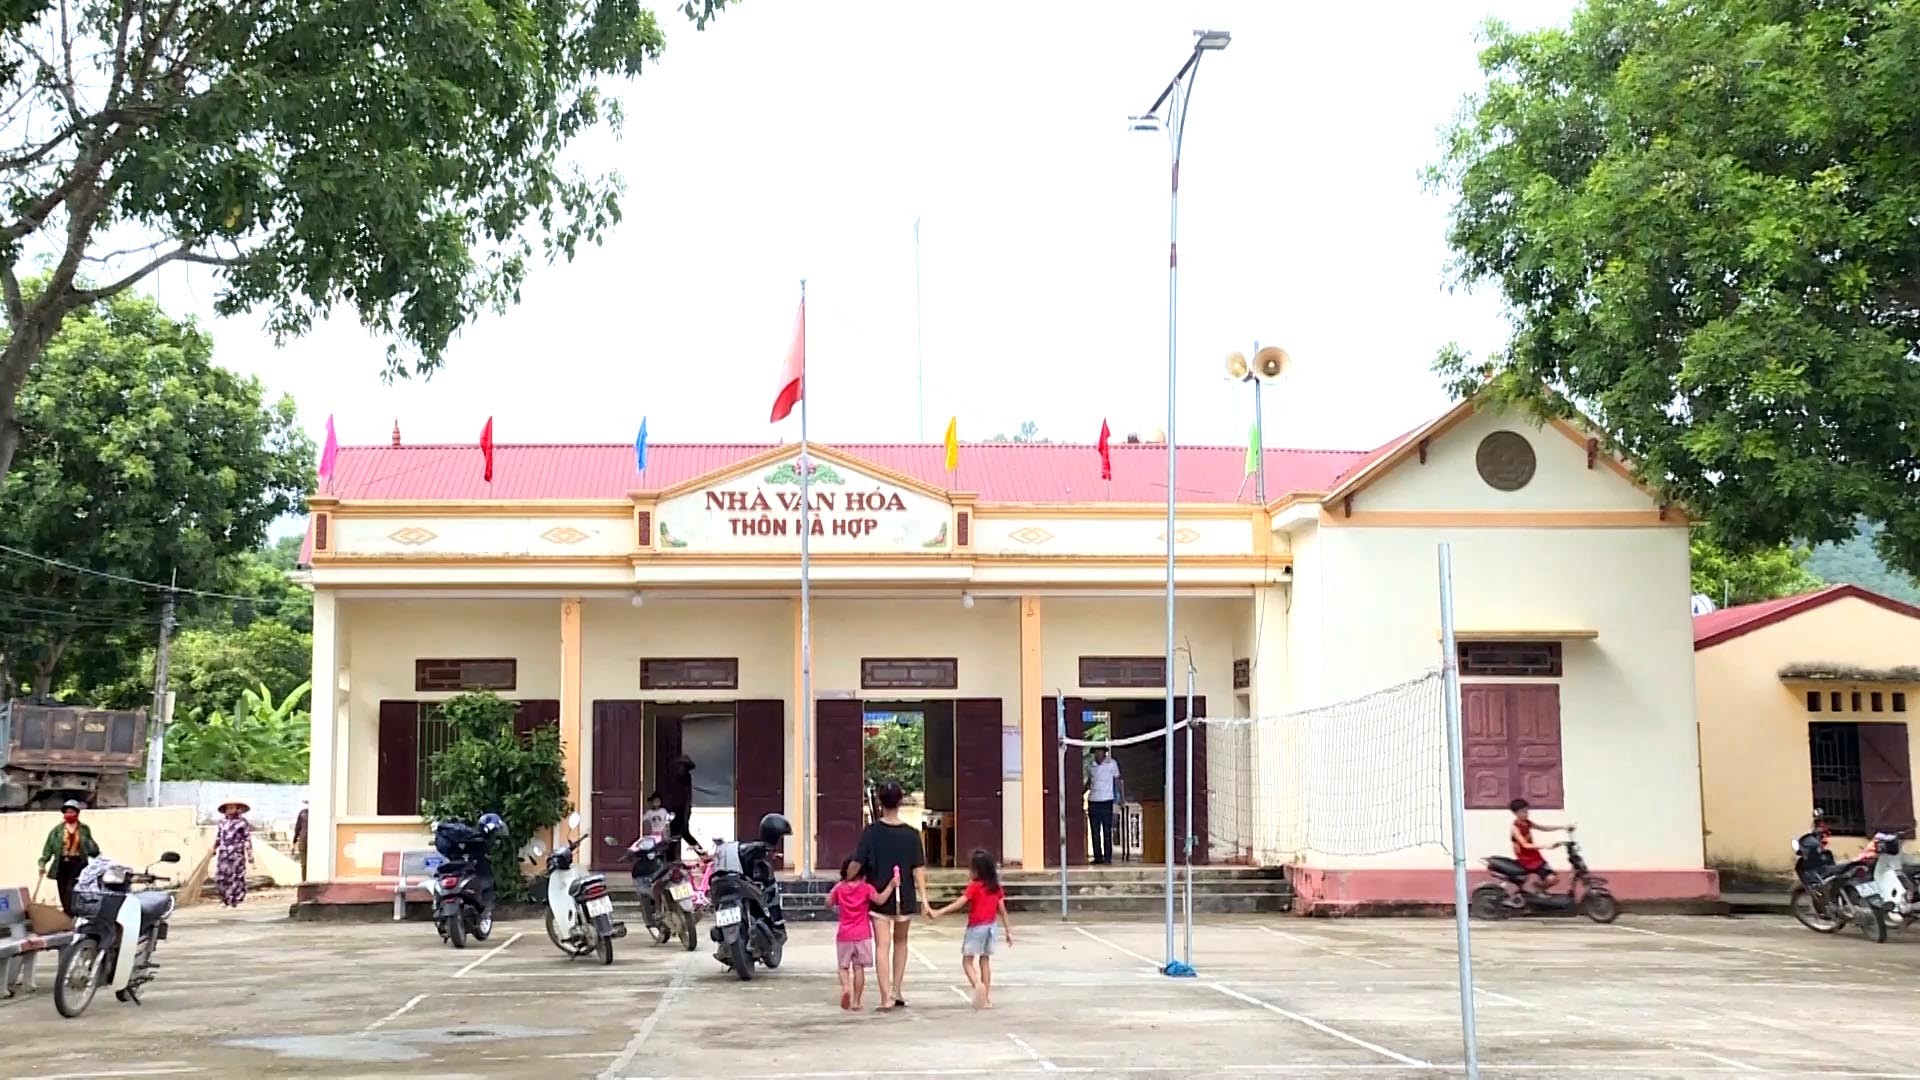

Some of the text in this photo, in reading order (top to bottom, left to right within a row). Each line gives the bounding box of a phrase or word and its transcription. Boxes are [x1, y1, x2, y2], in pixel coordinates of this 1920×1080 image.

[705, 486, 772, 510] NHÀ
[845, 486, 907, 511] HÓA
[728, 514, 787, 536] THÔN
[832, 517, 878, 540] HỢP
